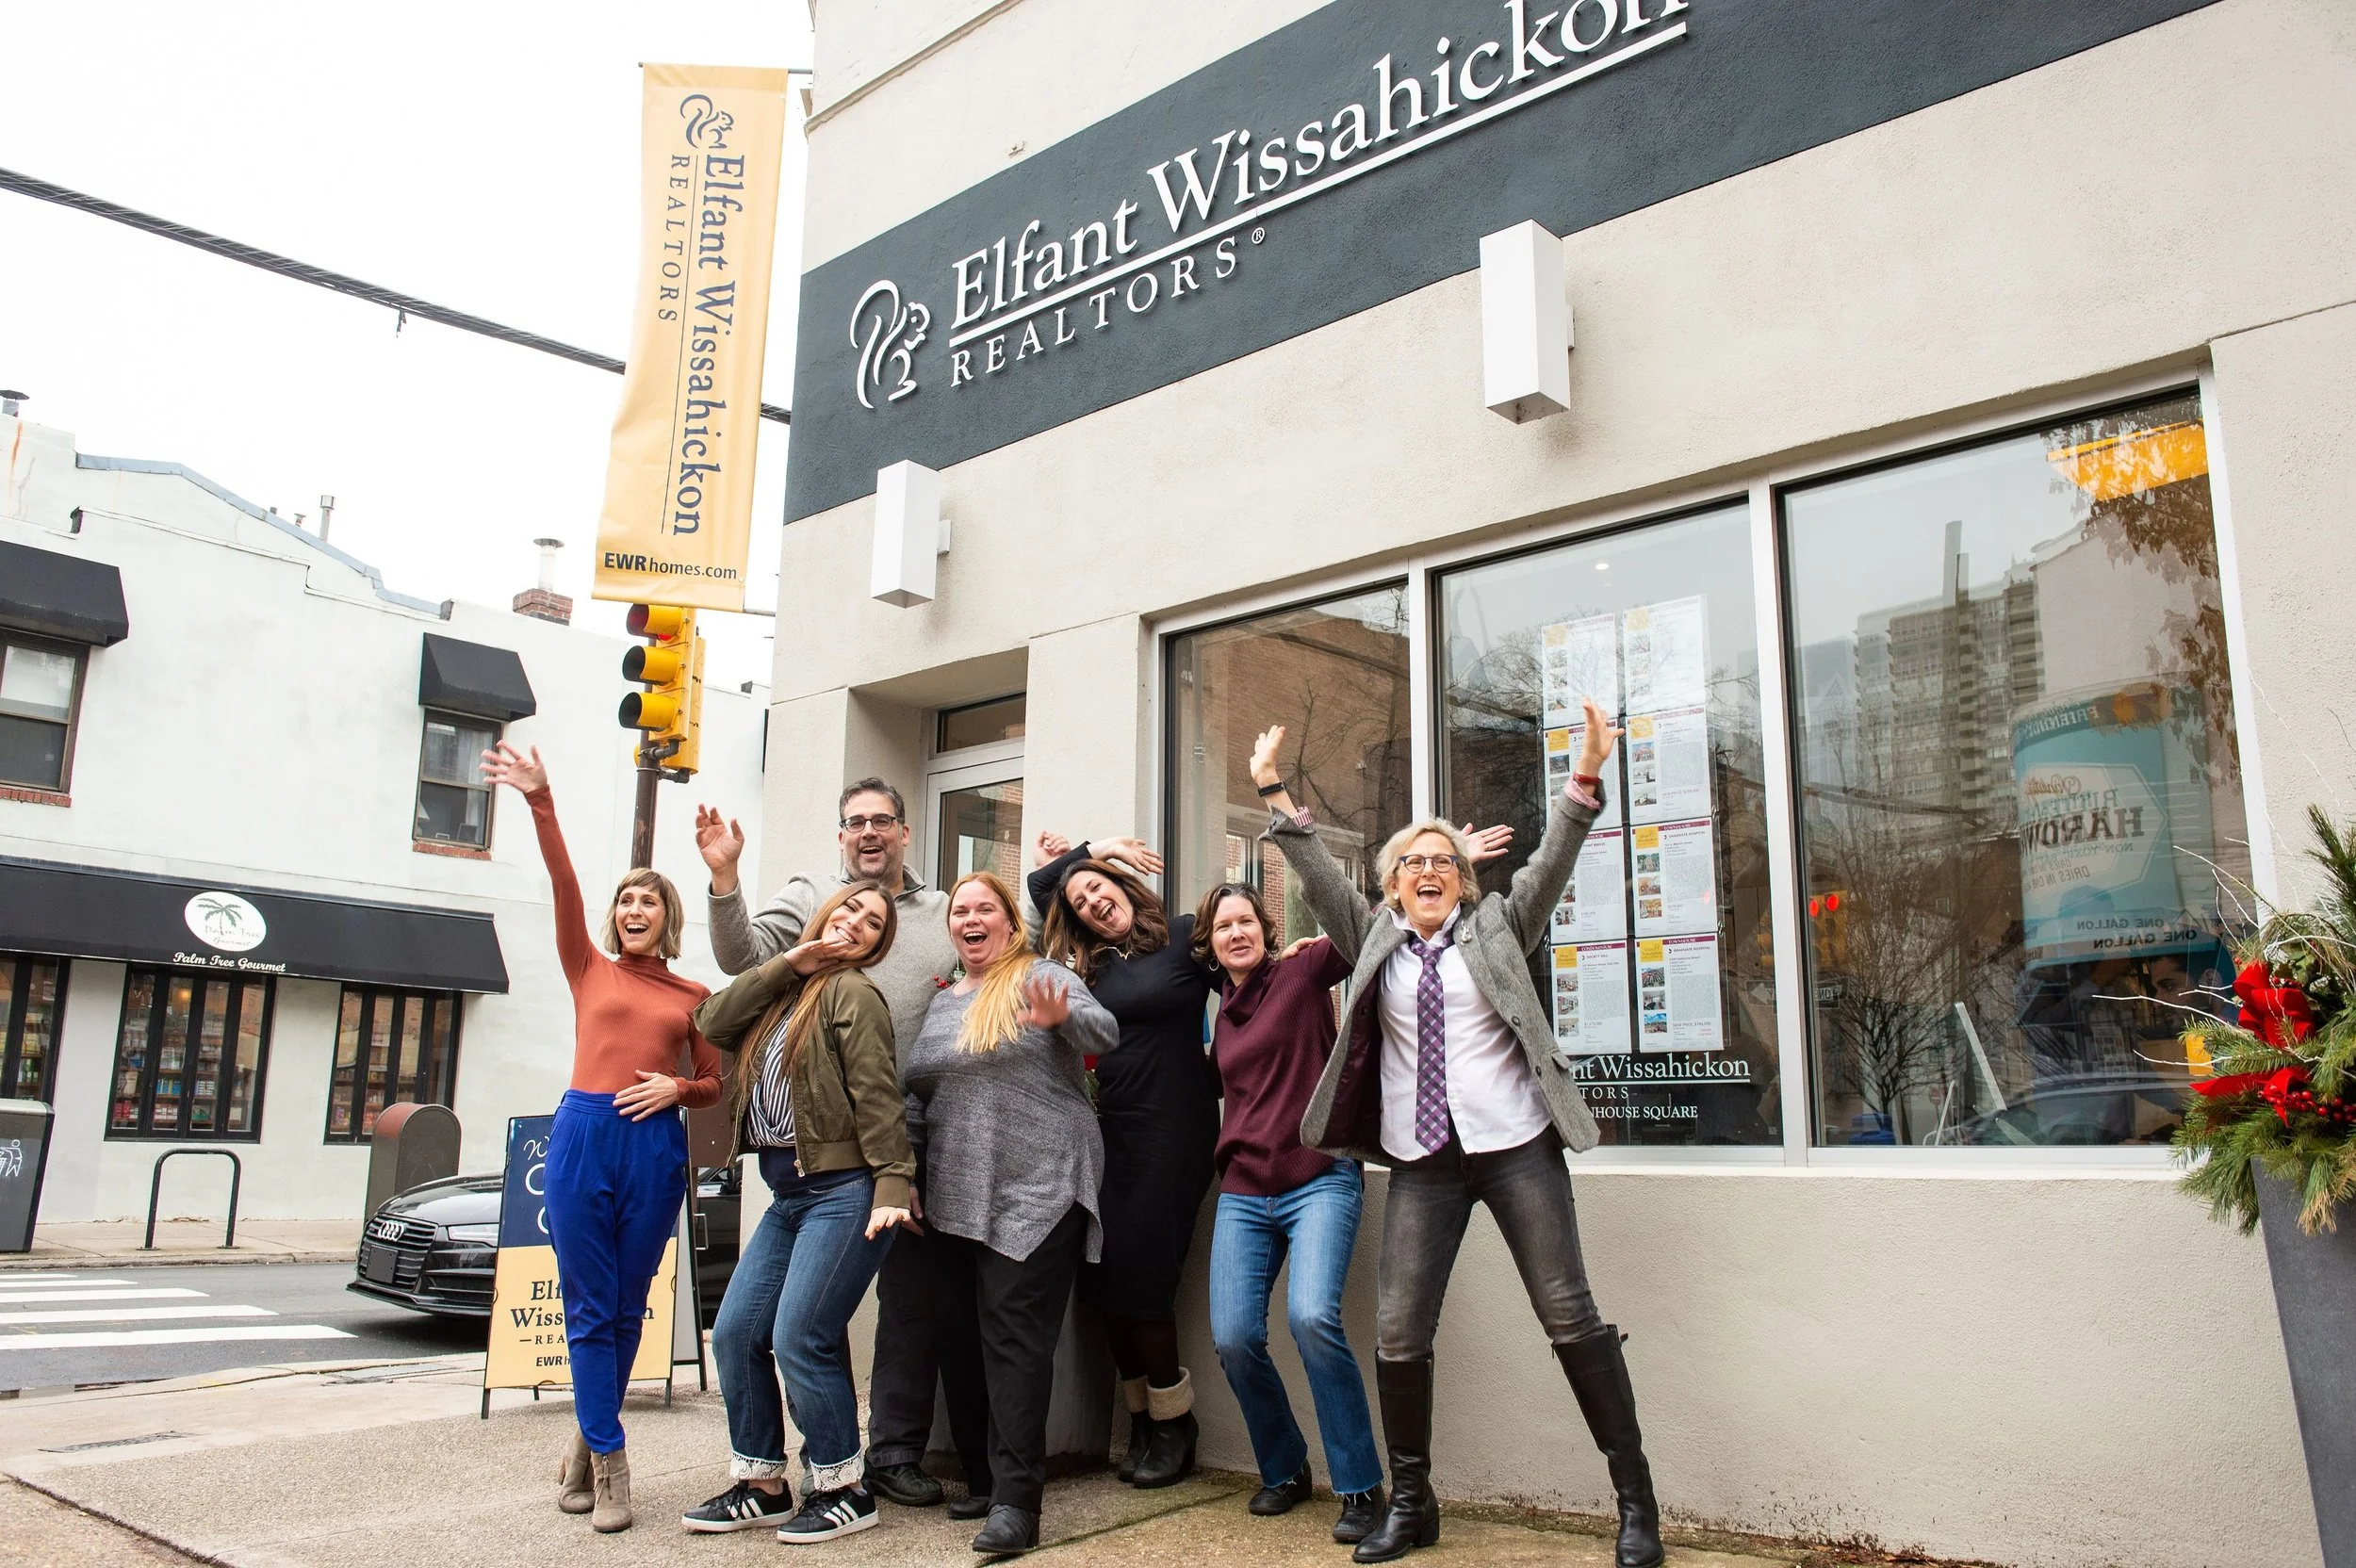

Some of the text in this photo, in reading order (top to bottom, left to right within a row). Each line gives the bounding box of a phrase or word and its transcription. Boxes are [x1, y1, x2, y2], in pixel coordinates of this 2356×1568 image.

[658, 155, 691, 322] REALTORS
[952, 198, 1137, 329] Elfant
[672, 154, 745, 536] Elfant Wissahickon
[603, 551, 738, 580] EWRhomes.com
[172, 951, 286, 972] Palm Tree Gourmet
[1597, 1052, 1751, 1079] Wissahickon
[1579, 1086, 1629, 1100] TORS
[1643, 1105, 1699, 1120] SQUARE
[531, 1279, 563, 1301] Elf
